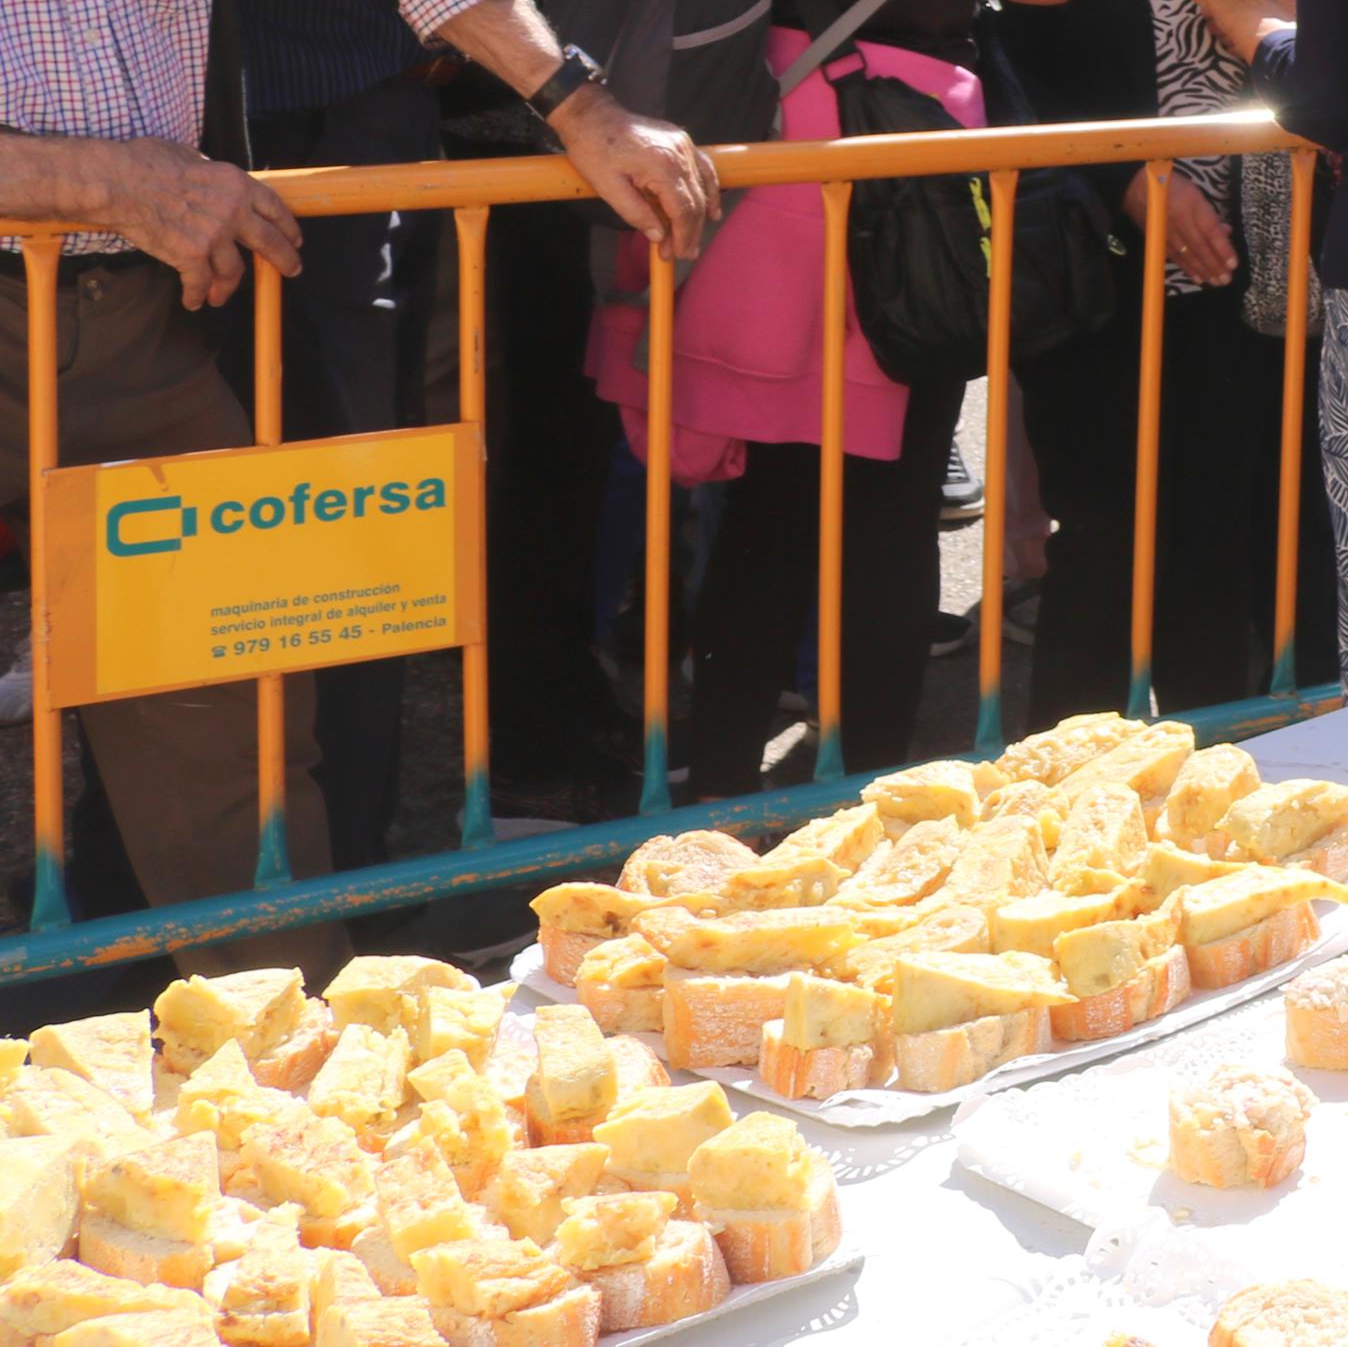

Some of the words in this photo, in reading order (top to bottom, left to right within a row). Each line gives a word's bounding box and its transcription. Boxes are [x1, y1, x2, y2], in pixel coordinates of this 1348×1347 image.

[210, 478, 446, 534] cofersa
[211, 597, 288, 617] maquinaria
[292, 594, 309, 607] de
[211, 618, 265, 635] servicio
[270, 610, 321, 627] integral
[327, 607, 342, 620] de
[347, 601, 396, 617] alquiler
[401, 600, 408, 613] y
[412, 594, 447, 607] venta
[234, 637, 270, 656] 979
[280, 633, 301, 649] 16
[308, 629, 331, 645] 55
[339, 625, 362, 640] 45
[382, 616, 447, 634] Palencia
